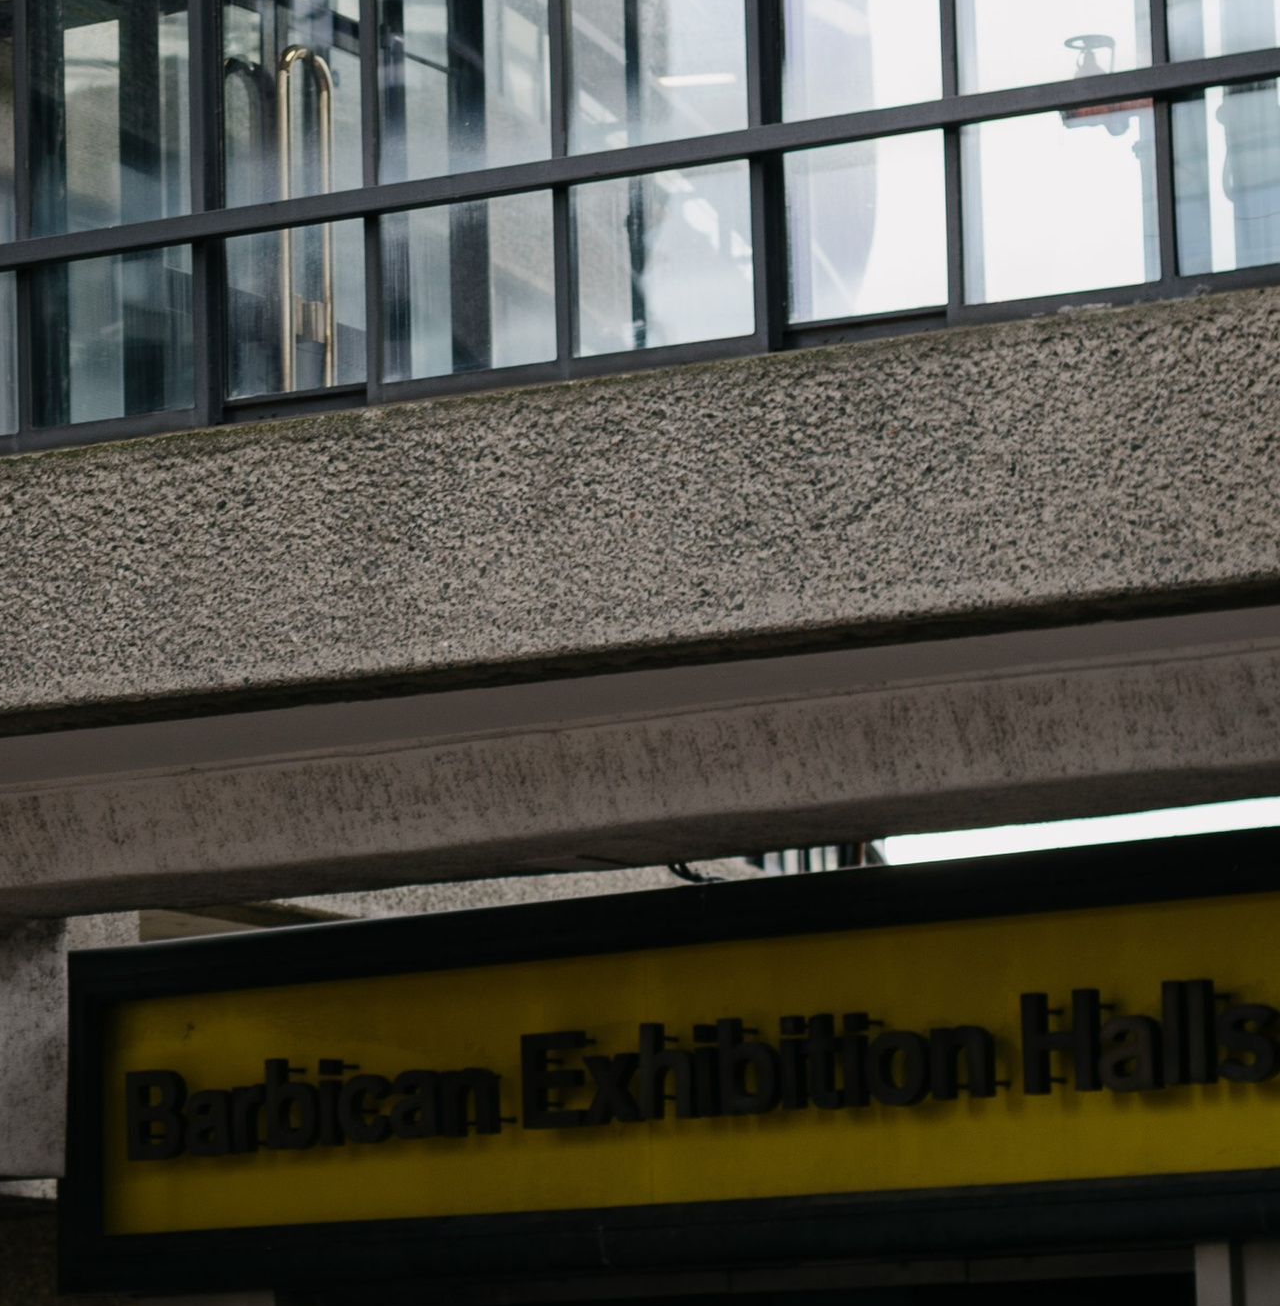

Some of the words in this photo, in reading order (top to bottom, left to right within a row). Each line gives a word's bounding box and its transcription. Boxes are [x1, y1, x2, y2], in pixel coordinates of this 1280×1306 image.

[126, 1059, 502, 1161] Barbican
[521, 1012, 996, 1129] Exhibition
[1021, 979, 1280, 1094] Halls
